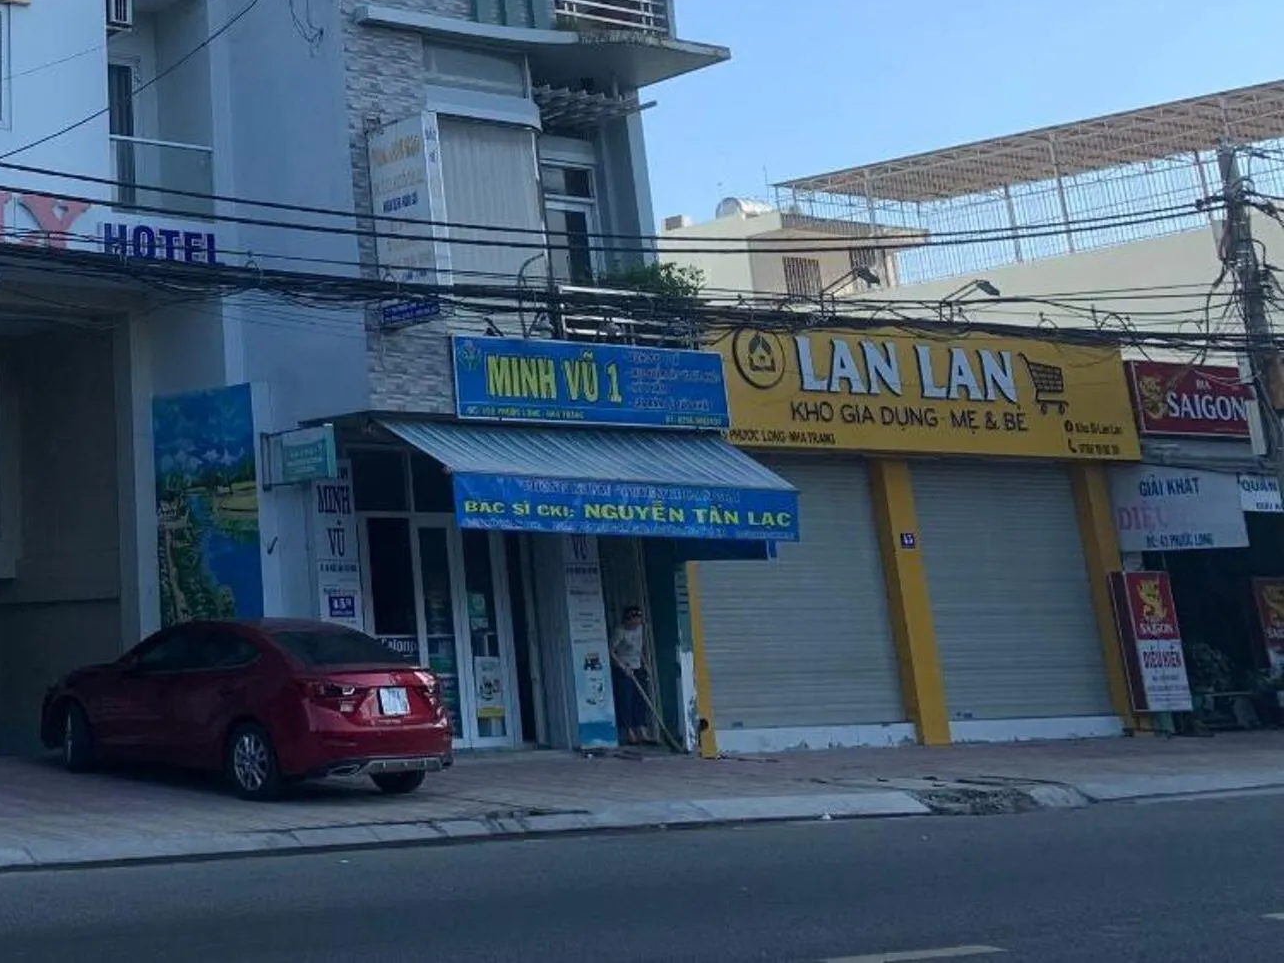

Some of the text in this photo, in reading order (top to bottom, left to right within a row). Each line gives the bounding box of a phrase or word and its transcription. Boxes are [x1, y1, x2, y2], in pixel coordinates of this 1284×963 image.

[102, 222, 223, 265] HOTEL
[486, 350, 622, 404] MINH VŨ 1
[794, 336, 1019, 404] LAN LAN
[791, 400, 835, 423] KHO
[840, 403, 876, 425] GIA
[881, 406, 939, 431] DỤNG
[950, 410, 978, 435] MẸ
[985, 411, 1000, 430] &
[1166, 392, 1247, 421] SAIGON
[316, 485, 351, 514] MINH
[1139, 474, 1164, 497] GIẢI
[585, 498, 685, 525] NGUYỄN
[747, 509, 793, 529] LẠC
